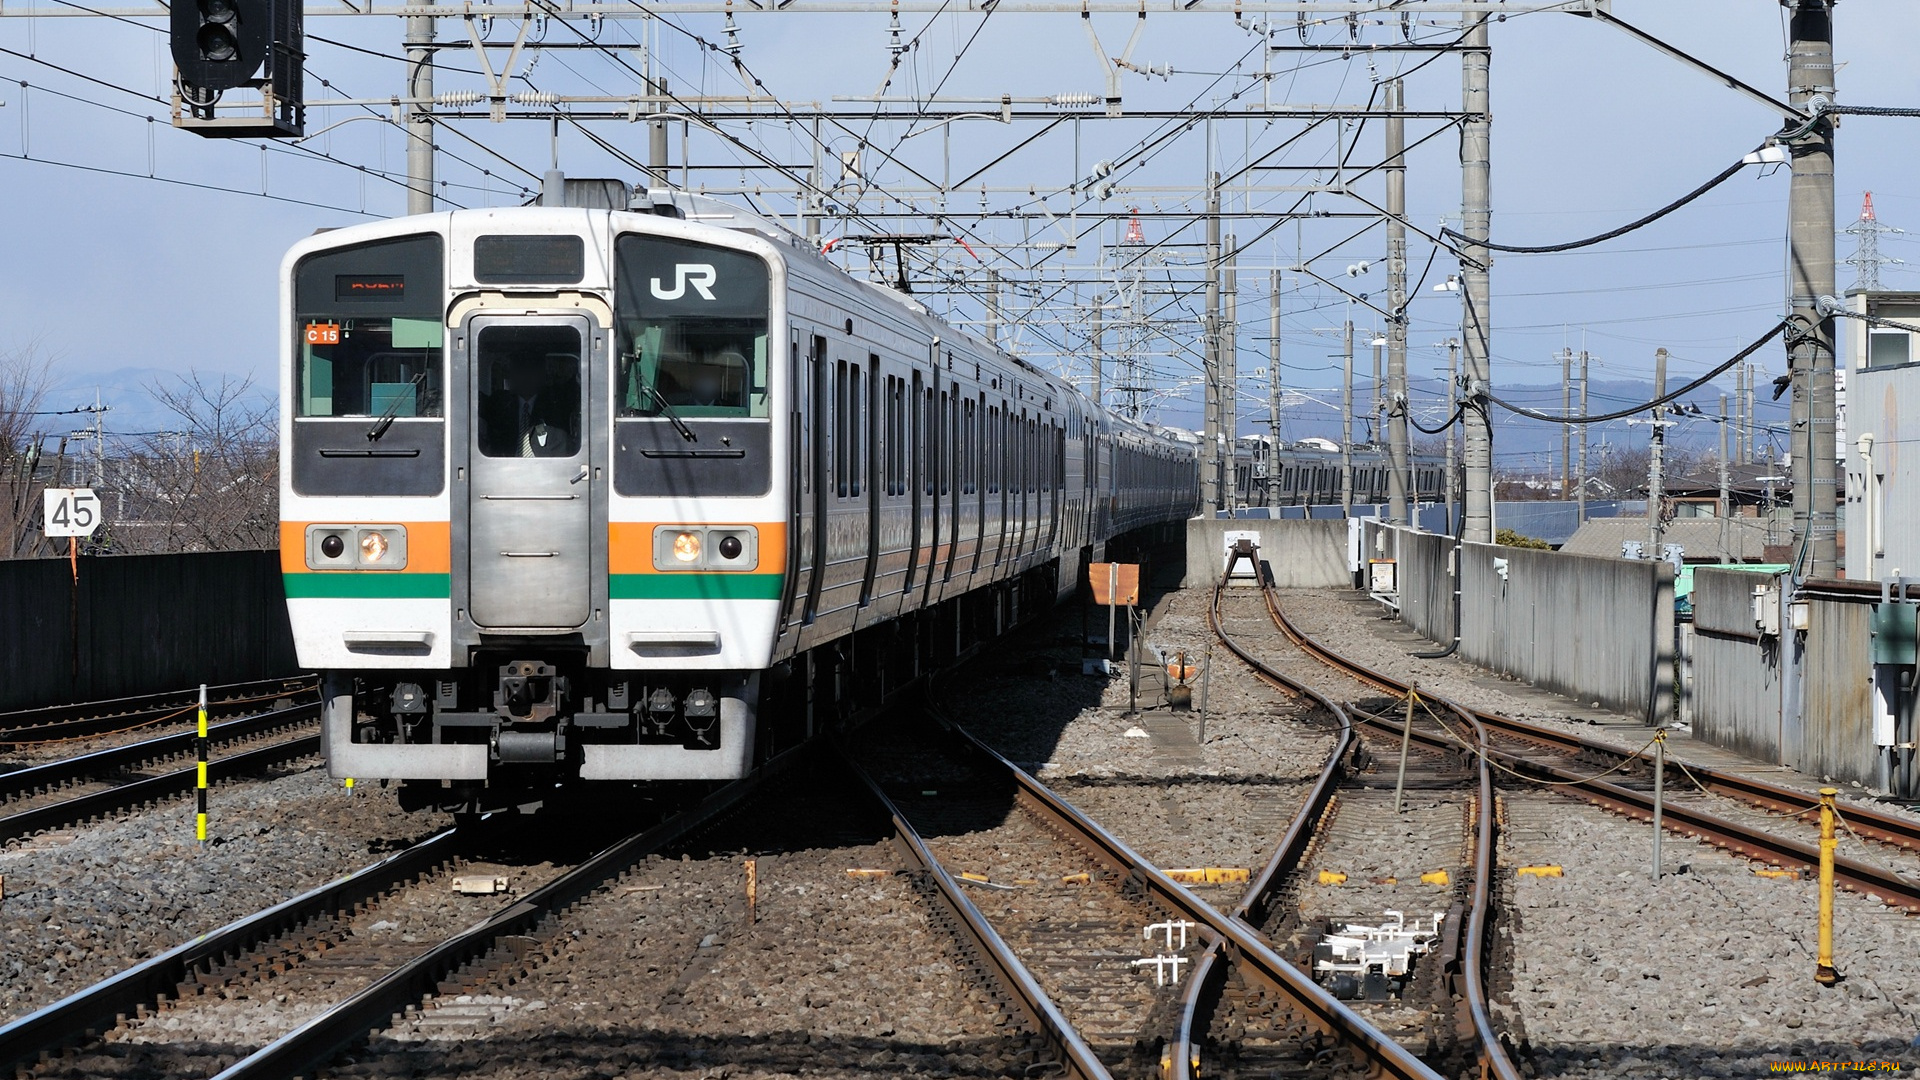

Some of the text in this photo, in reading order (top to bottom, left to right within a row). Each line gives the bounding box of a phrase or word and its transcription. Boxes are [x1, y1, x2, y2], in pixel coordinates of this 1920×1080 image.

[650, 263, 717, 300] JR
[308, 330, 337, 341] C 15
[51, 496, 94, 528] 45
